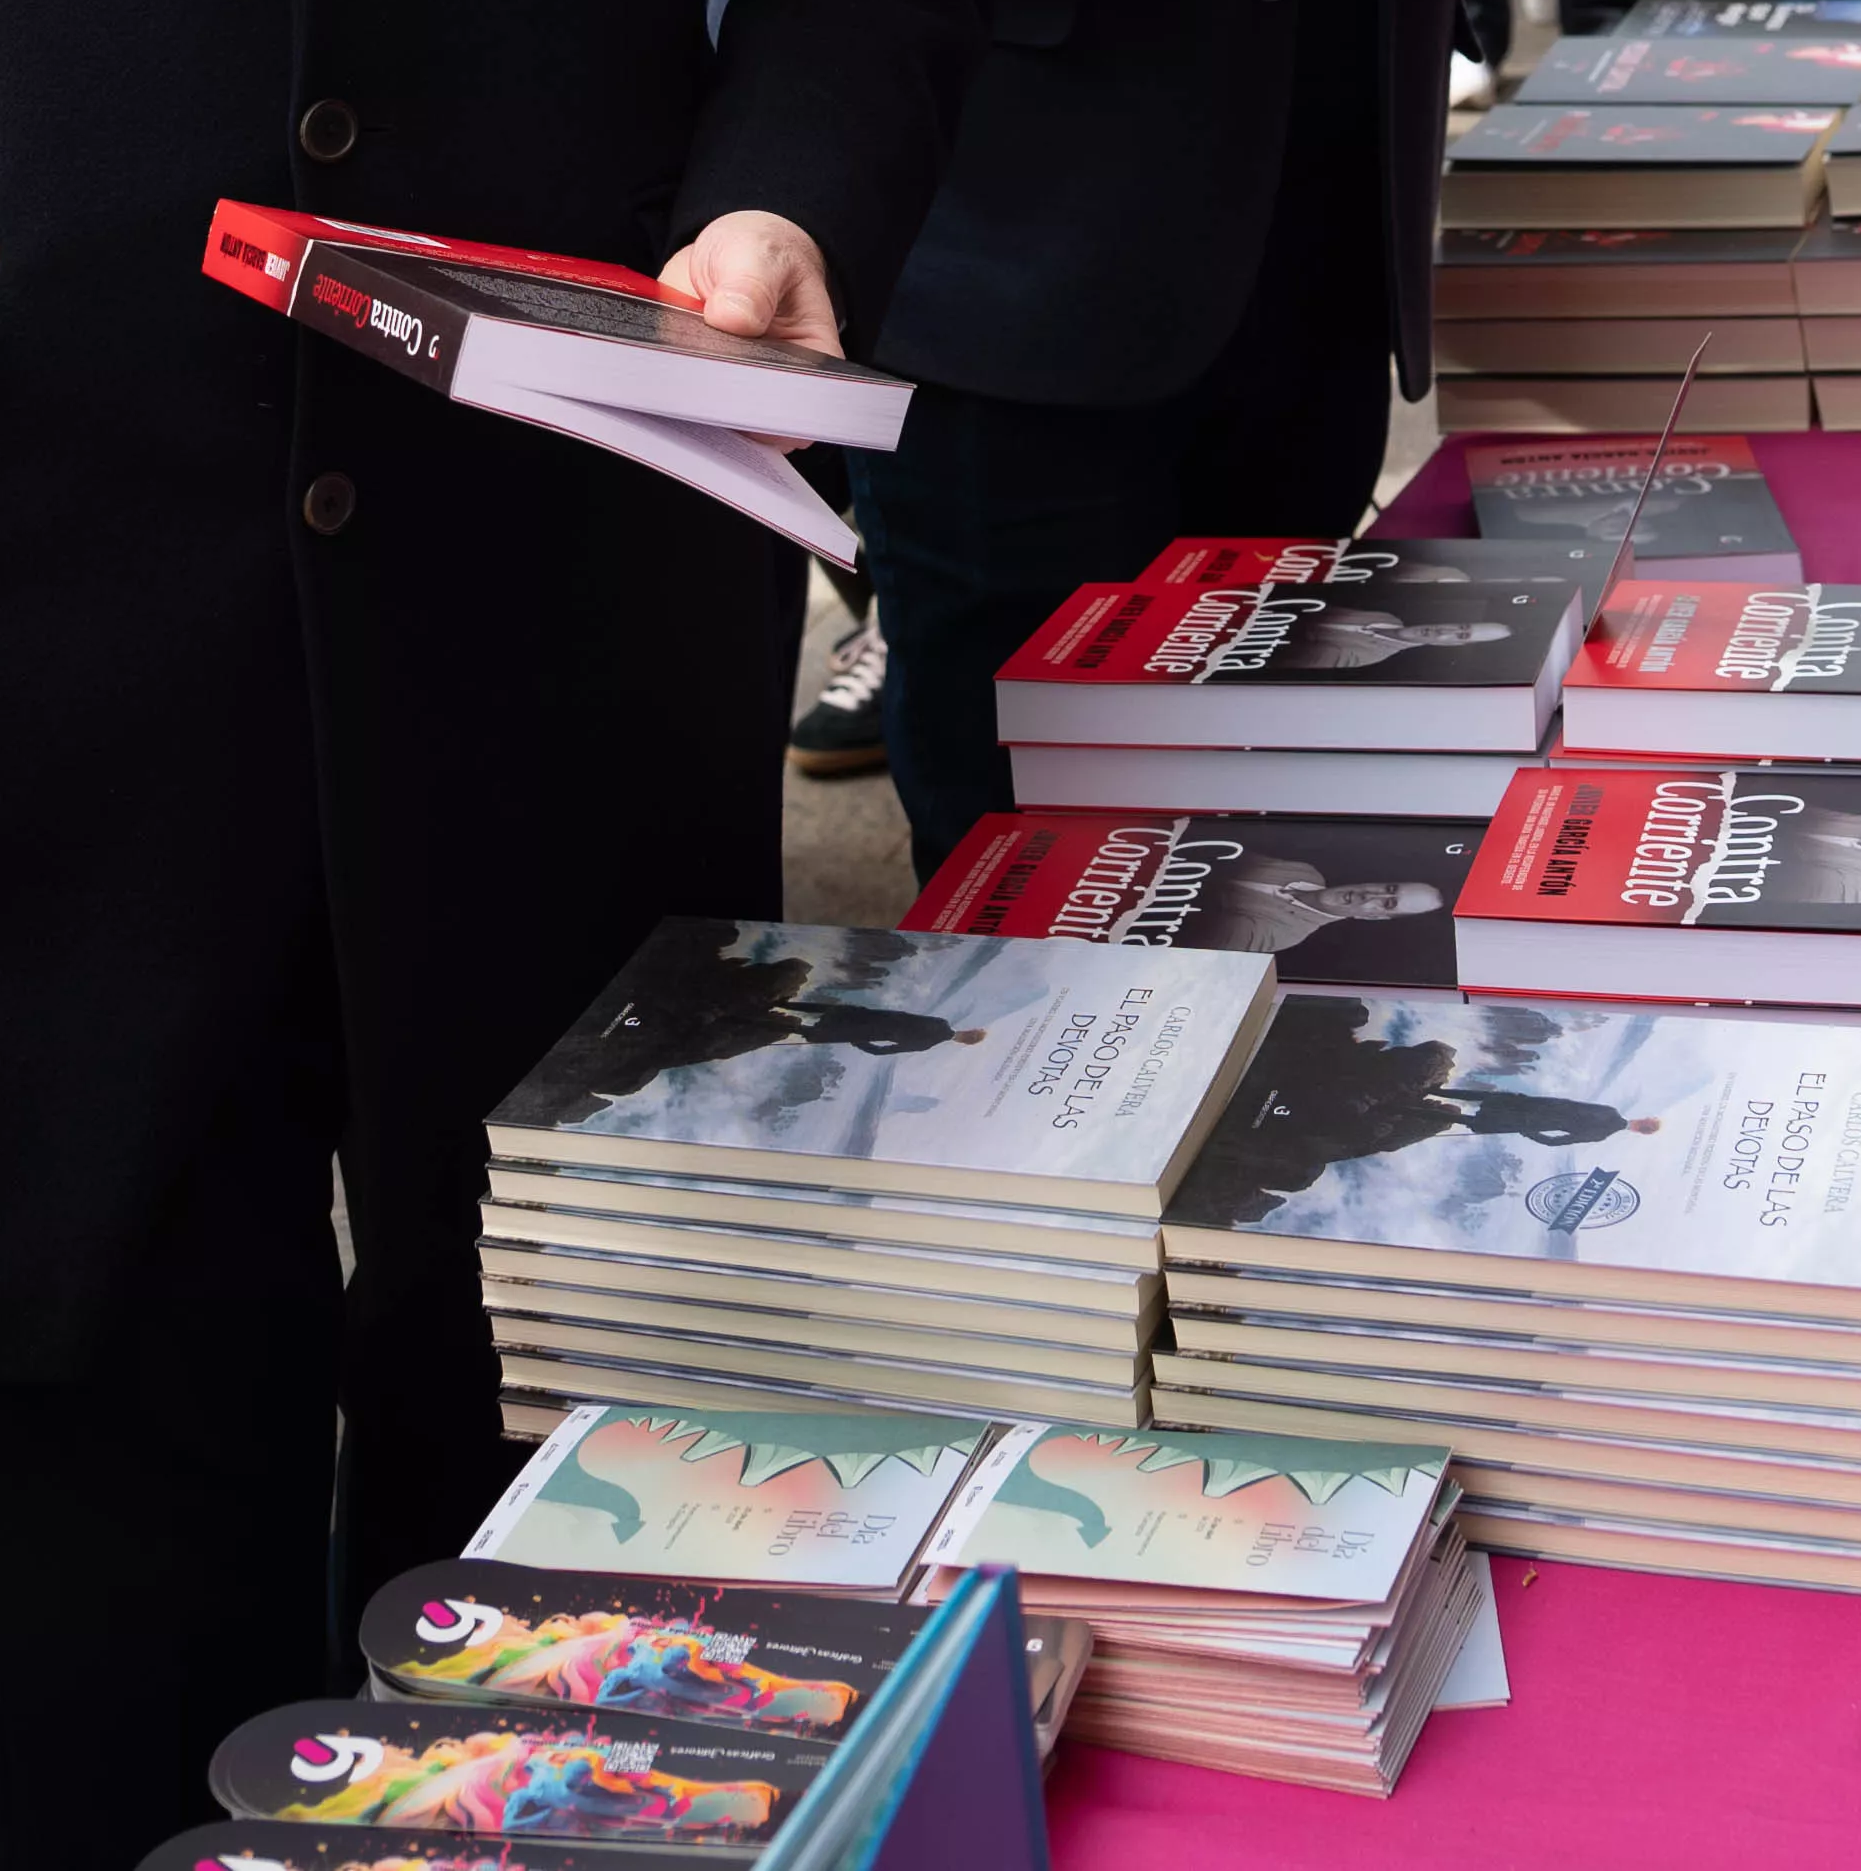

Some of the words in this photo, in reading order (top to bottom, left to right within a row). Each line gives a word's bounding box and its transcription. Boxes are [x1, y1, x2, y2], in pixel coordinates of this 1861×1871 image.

[312, 273, 372, 329] Corriente
[370, 298, 423, 356] Contra
[1143, 589, 1270, 675] Corriente
[1227, 597, 1327, 672] Contra
[1714, 590, 1811, 681] Corriente
[1550, 817, 1594, 857] GARCÍA
[1621, 781, 1727, 907] Corriente
[1703, 794, 1805, 905] Contra
[1043, 827, 1174, 943] Corrient
[1120, 841, 1244, 948] Contra
[1537, 859, 1578, 897] ANTÓN
[967, 903, 1009, 935] ANTÓ
[1120, 988, 1154, 1010] EL
[1028, 1013, 1097, 1096] DEVOTAS
[1093, 1014, 1140, 1061] PASO
[1149, 1006, 1191, 1057] CARLOS
[1074, 1064, 1112, 1091] DE
[1114, 1058, 1164, 1118] CALVERA
[1796, 1072, 1827, 1096] EL
[1052, 1094, 1094, 1129] LAS
[1781, 1100, 1820, 1152] PASO
[1723, 1100, 1774, 1190] DEVOTAS
[1771, 1155, 1805, 1185] DE
[1823, 1148, 1860, 1214] CALVERA
[1558, 1188, 1598, 1228] EDICIÓN
[1759, 1188, 1796, 1227] LAS
[768, 1509, 804, 1556] Libro
[819, 1512, 850, 1540] del
[851, 1514, 897, 1545] Día
[1245, 1522, 1296, 1568] Libro
[1294, 1526, 1328, 1554] del
[1336, 1529, 1375, 1560] Día
[817, 1647, 863, 1664] Gráficas
[728, 1747, 776, 1761] Gráficas
